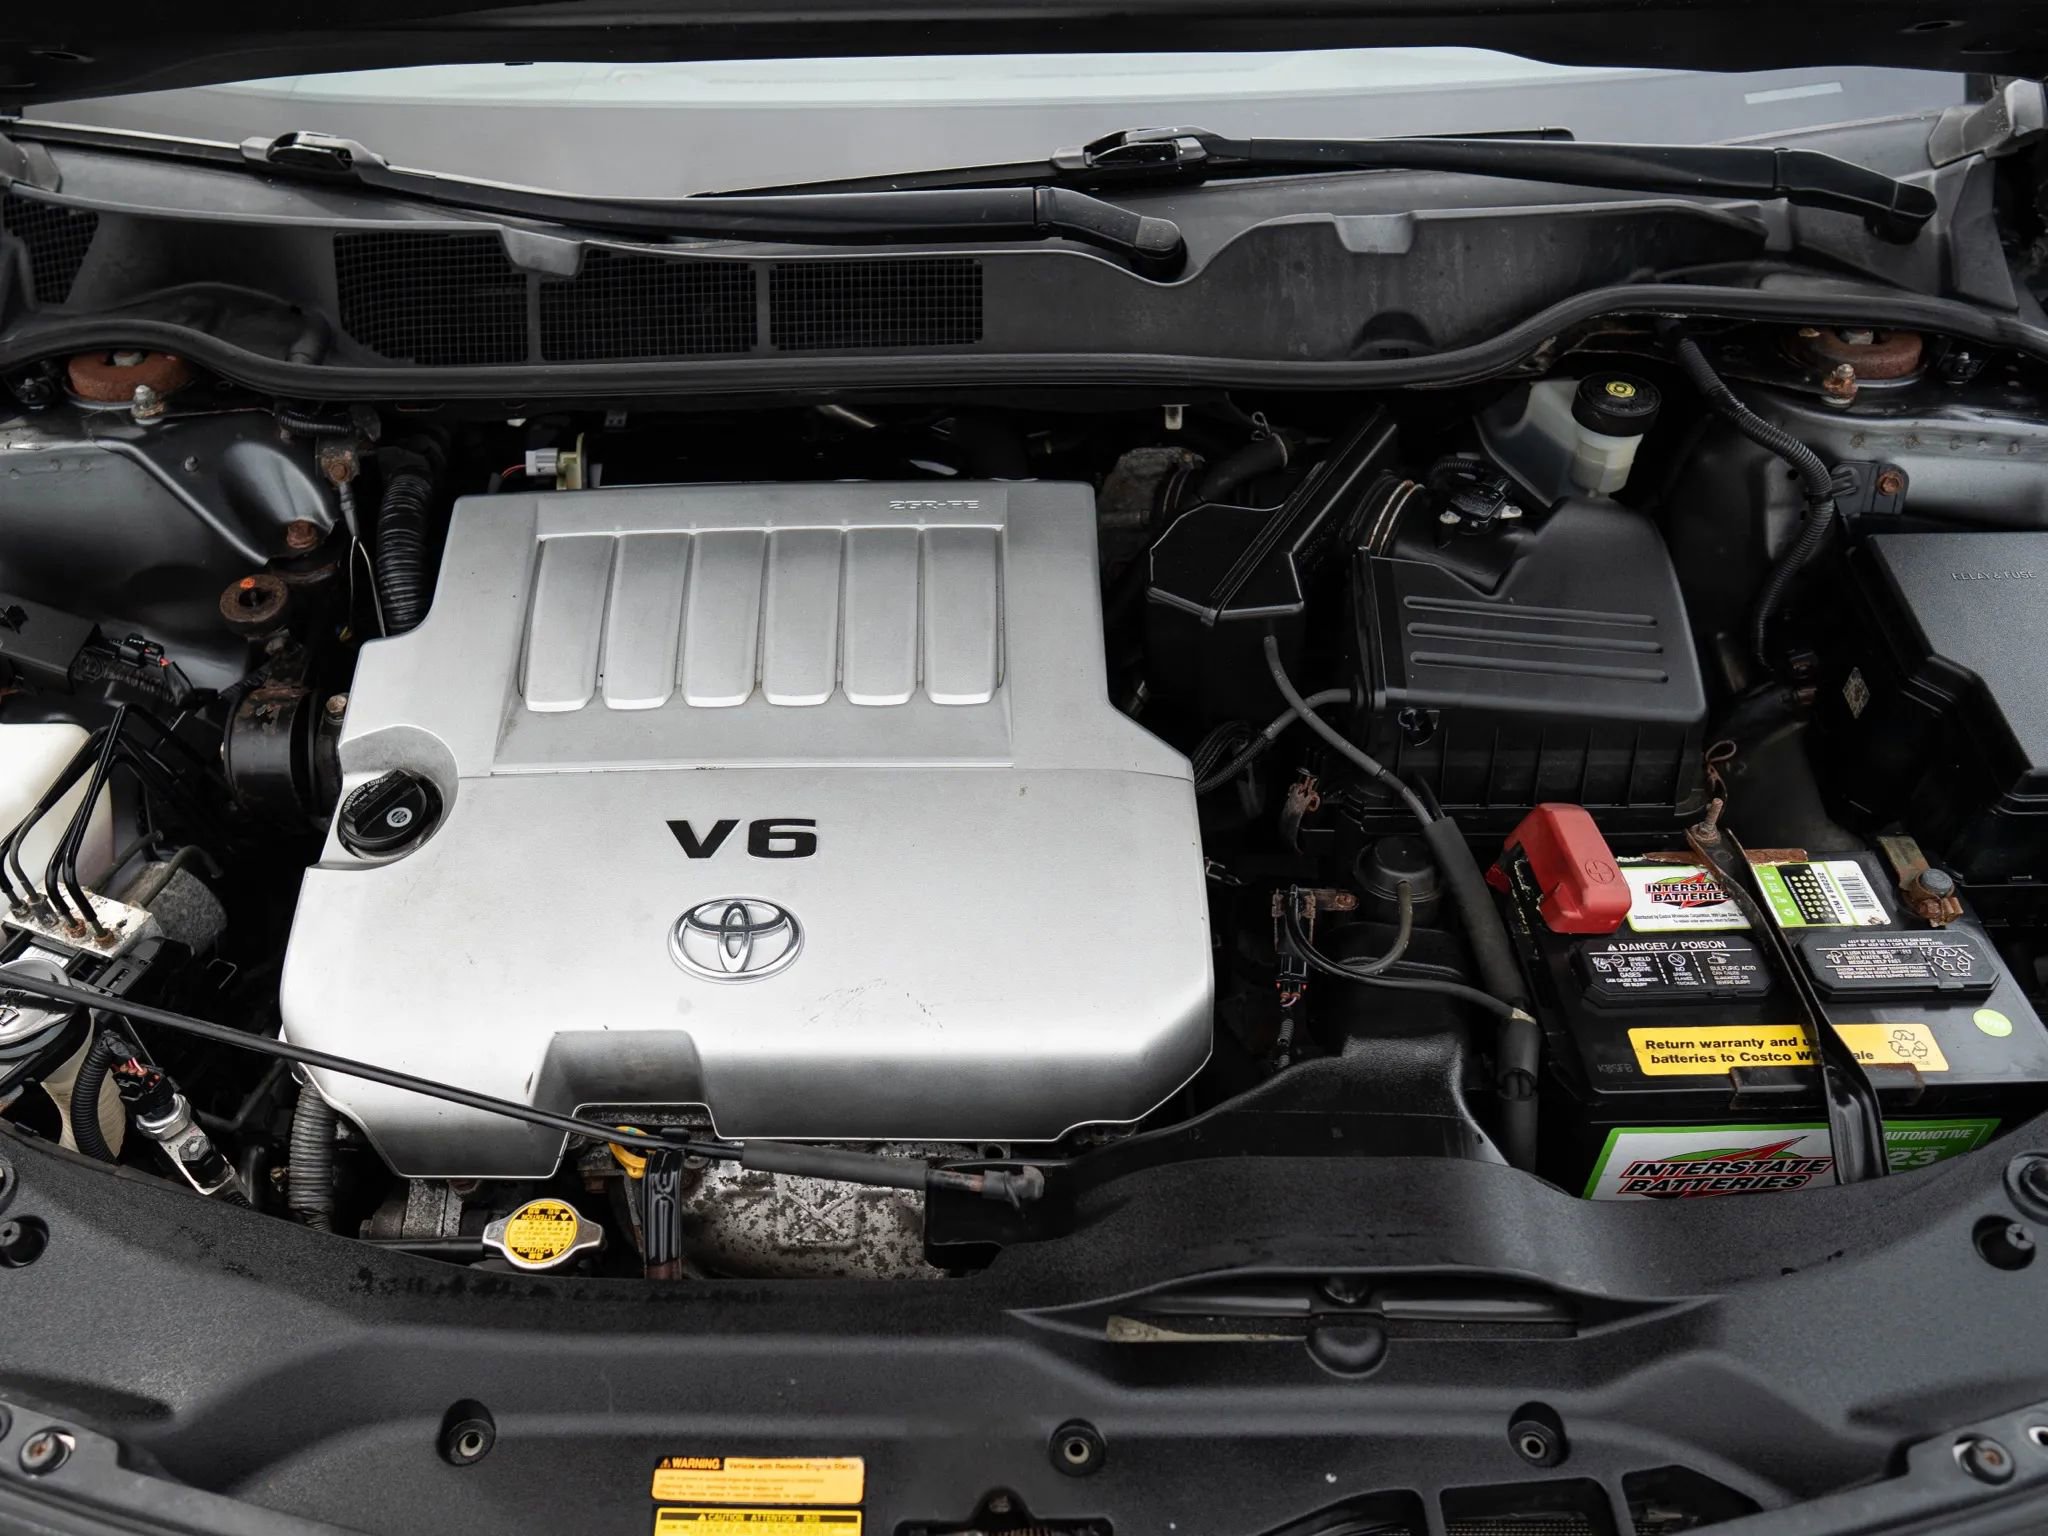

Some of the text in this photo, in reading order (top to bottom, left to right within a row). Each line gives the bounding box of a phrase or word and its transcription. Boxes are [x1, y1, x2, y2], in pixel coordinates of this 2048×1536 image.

[889, 500, 979, 510] 2GR-FE
[2004, 571, 2037, 579] FUSE
[666, 818, 817, 858] V6
[1646, 883, 1730, 893] INTERSTAT
[1653, 892, 1730, 902] BATTERIES
[1619, 942, 1669, 951] DANGER
[1680, 940, 1727, 949] POISON
[1645, 1040, 1695, 1050] Return
[1700, 1038, 1764, 1049] warranty
[1770, 1037, 1798, 1047] and
[1651, 1054, 1717, 1064] batteries
[1721, 1053, 1735, 1062] to
[1740, 1051, 1792, 1062] Costco
[1885, 1129, 1975, 1141] AUTOMOTIVE
[1888, 1150, 1940, 1167] 23
[1626, 1159, 1833, 1177] INTERSTATE
[1623, 1174, 1808, 1193] BATTERIES
[672, 1457, 720, 1469] WARNING
[707, 1513, 745, 1522] CAUTION
